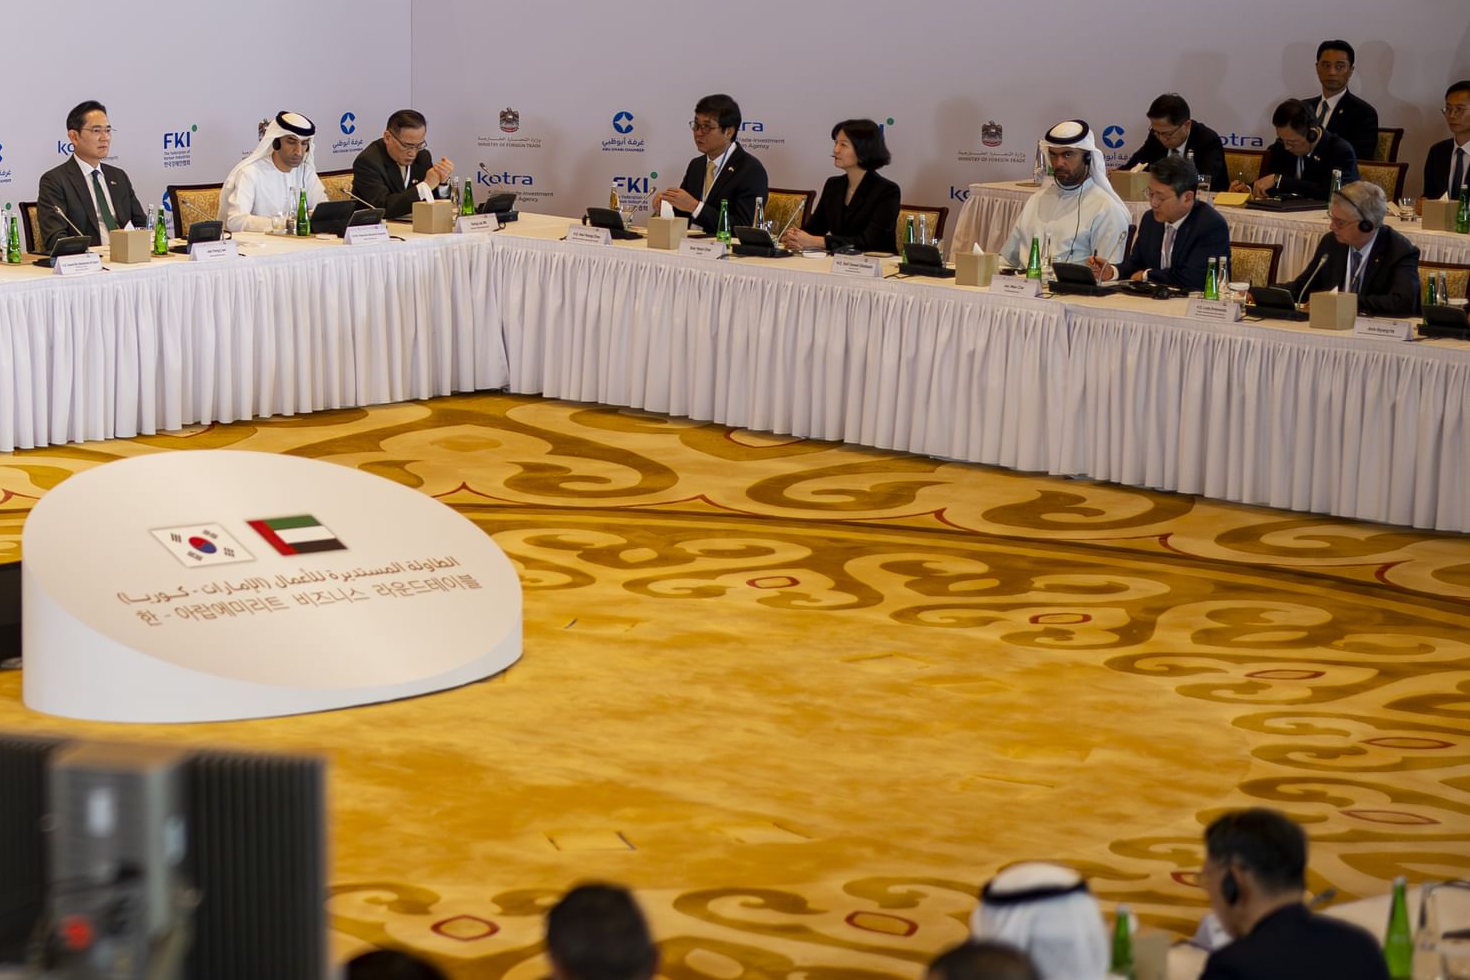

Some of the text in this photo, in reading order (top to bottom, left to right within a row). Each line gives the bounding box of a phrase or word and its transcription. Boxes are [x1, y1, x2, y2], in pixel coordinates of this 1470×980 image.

[164, 132, 190, 150] FKI
[477, 171, 534, 187] kotra
[329, 562, 407, 582] المستديرة
[408, 555, 462, 573] الطاولة
[274, 567, 326, 589] للأعمال
[135, 609, 163, 627] 한
[174, 596, 291, 621] 아랍에미리트
[291, 587, 371, 608] 비즈니스
[371, 573, 483, 599] 라운드테이블
